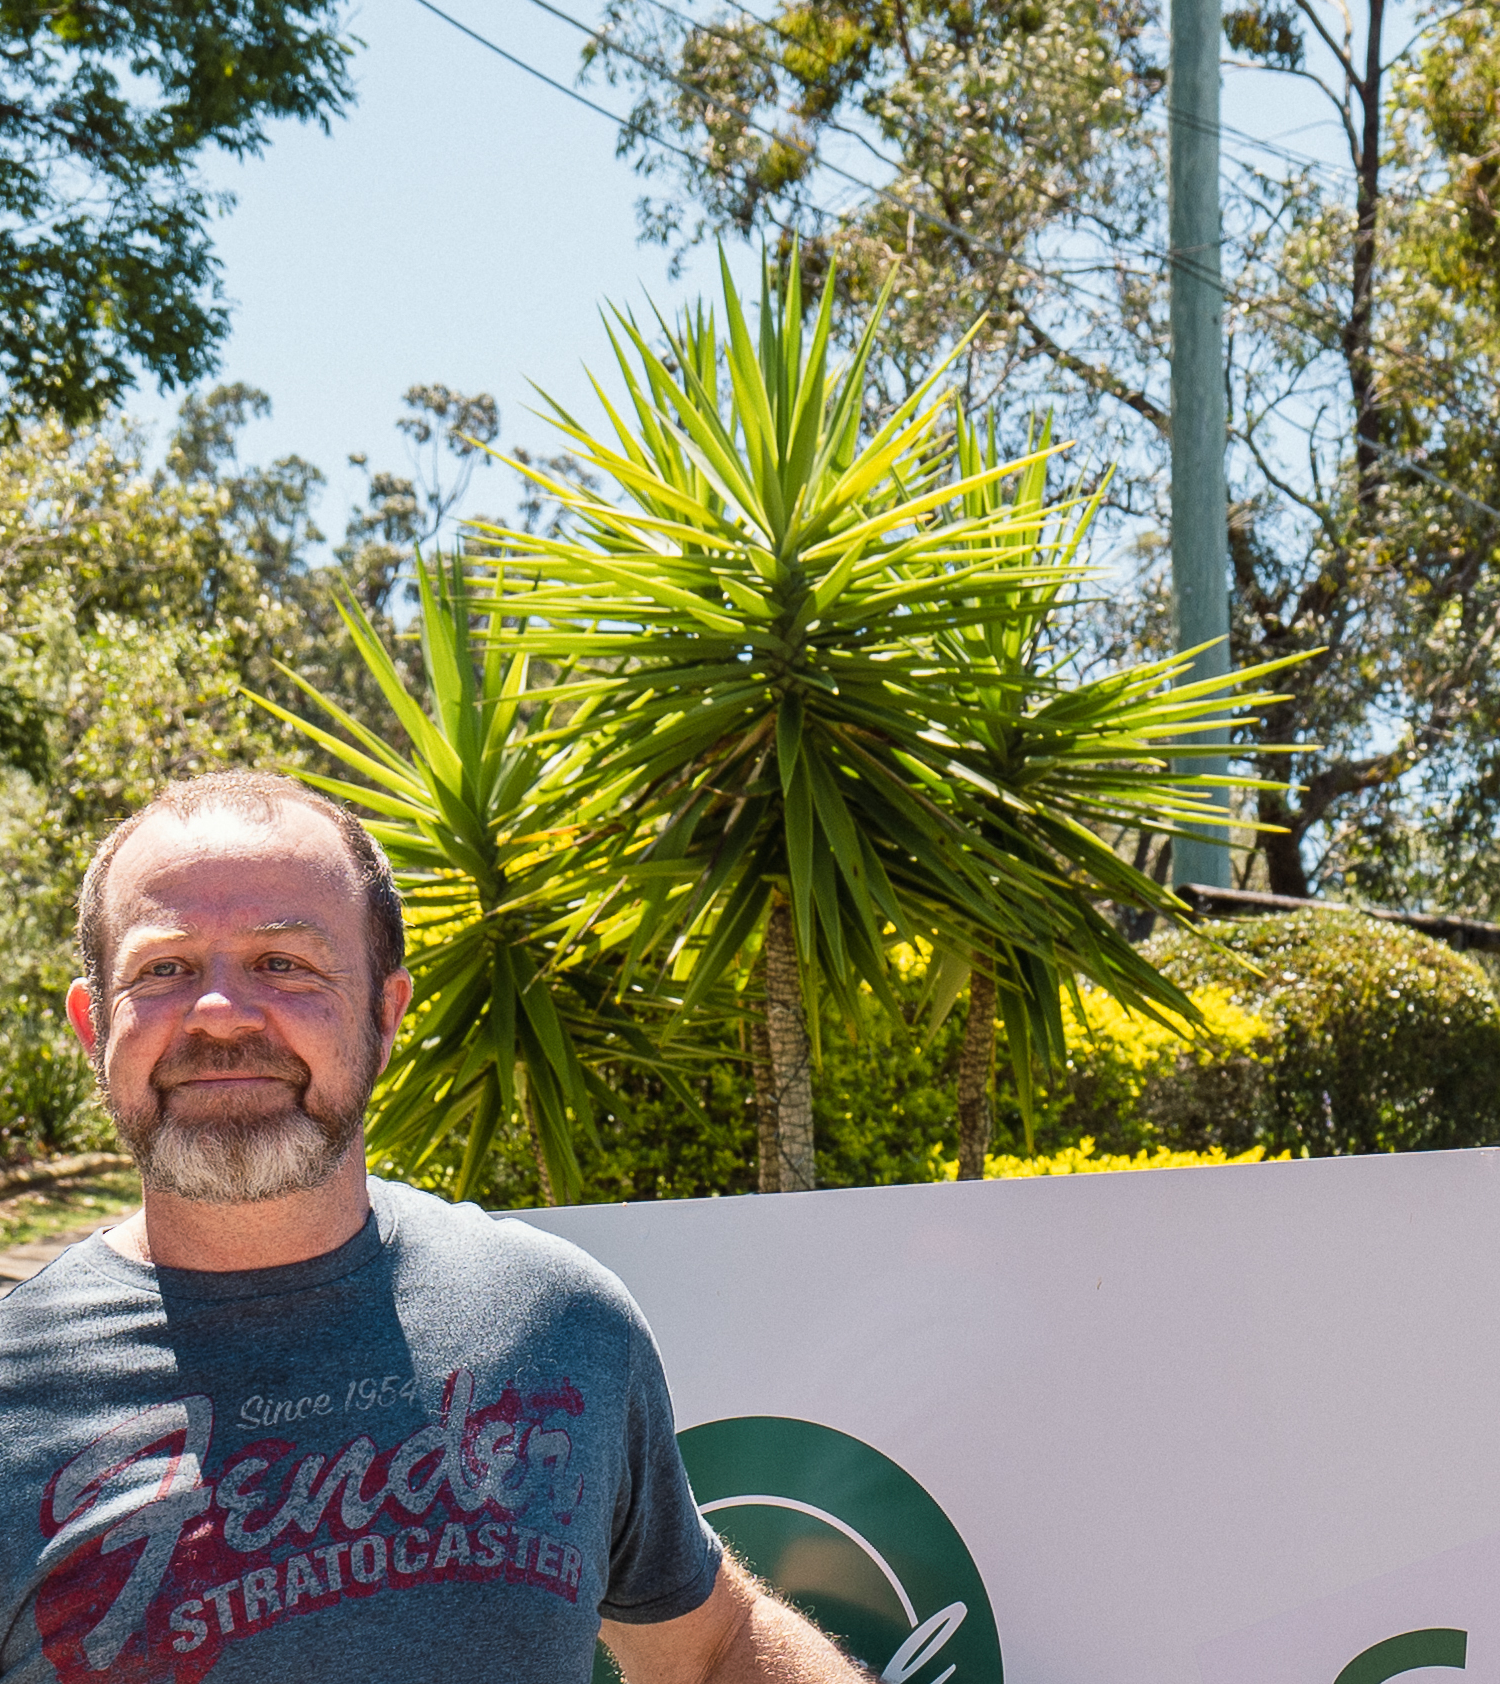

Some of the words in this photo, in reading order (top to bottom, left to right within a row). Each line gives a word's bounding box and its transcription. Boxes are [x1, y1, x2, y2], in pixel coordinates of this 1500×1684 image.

[236, 1393, 334, 1430] Since
[345, 1375, 421, 1411] 1954
[38, 1366, 586, 1673] Fender
[170, 1521, 584, 1654] STRATOCASTER
